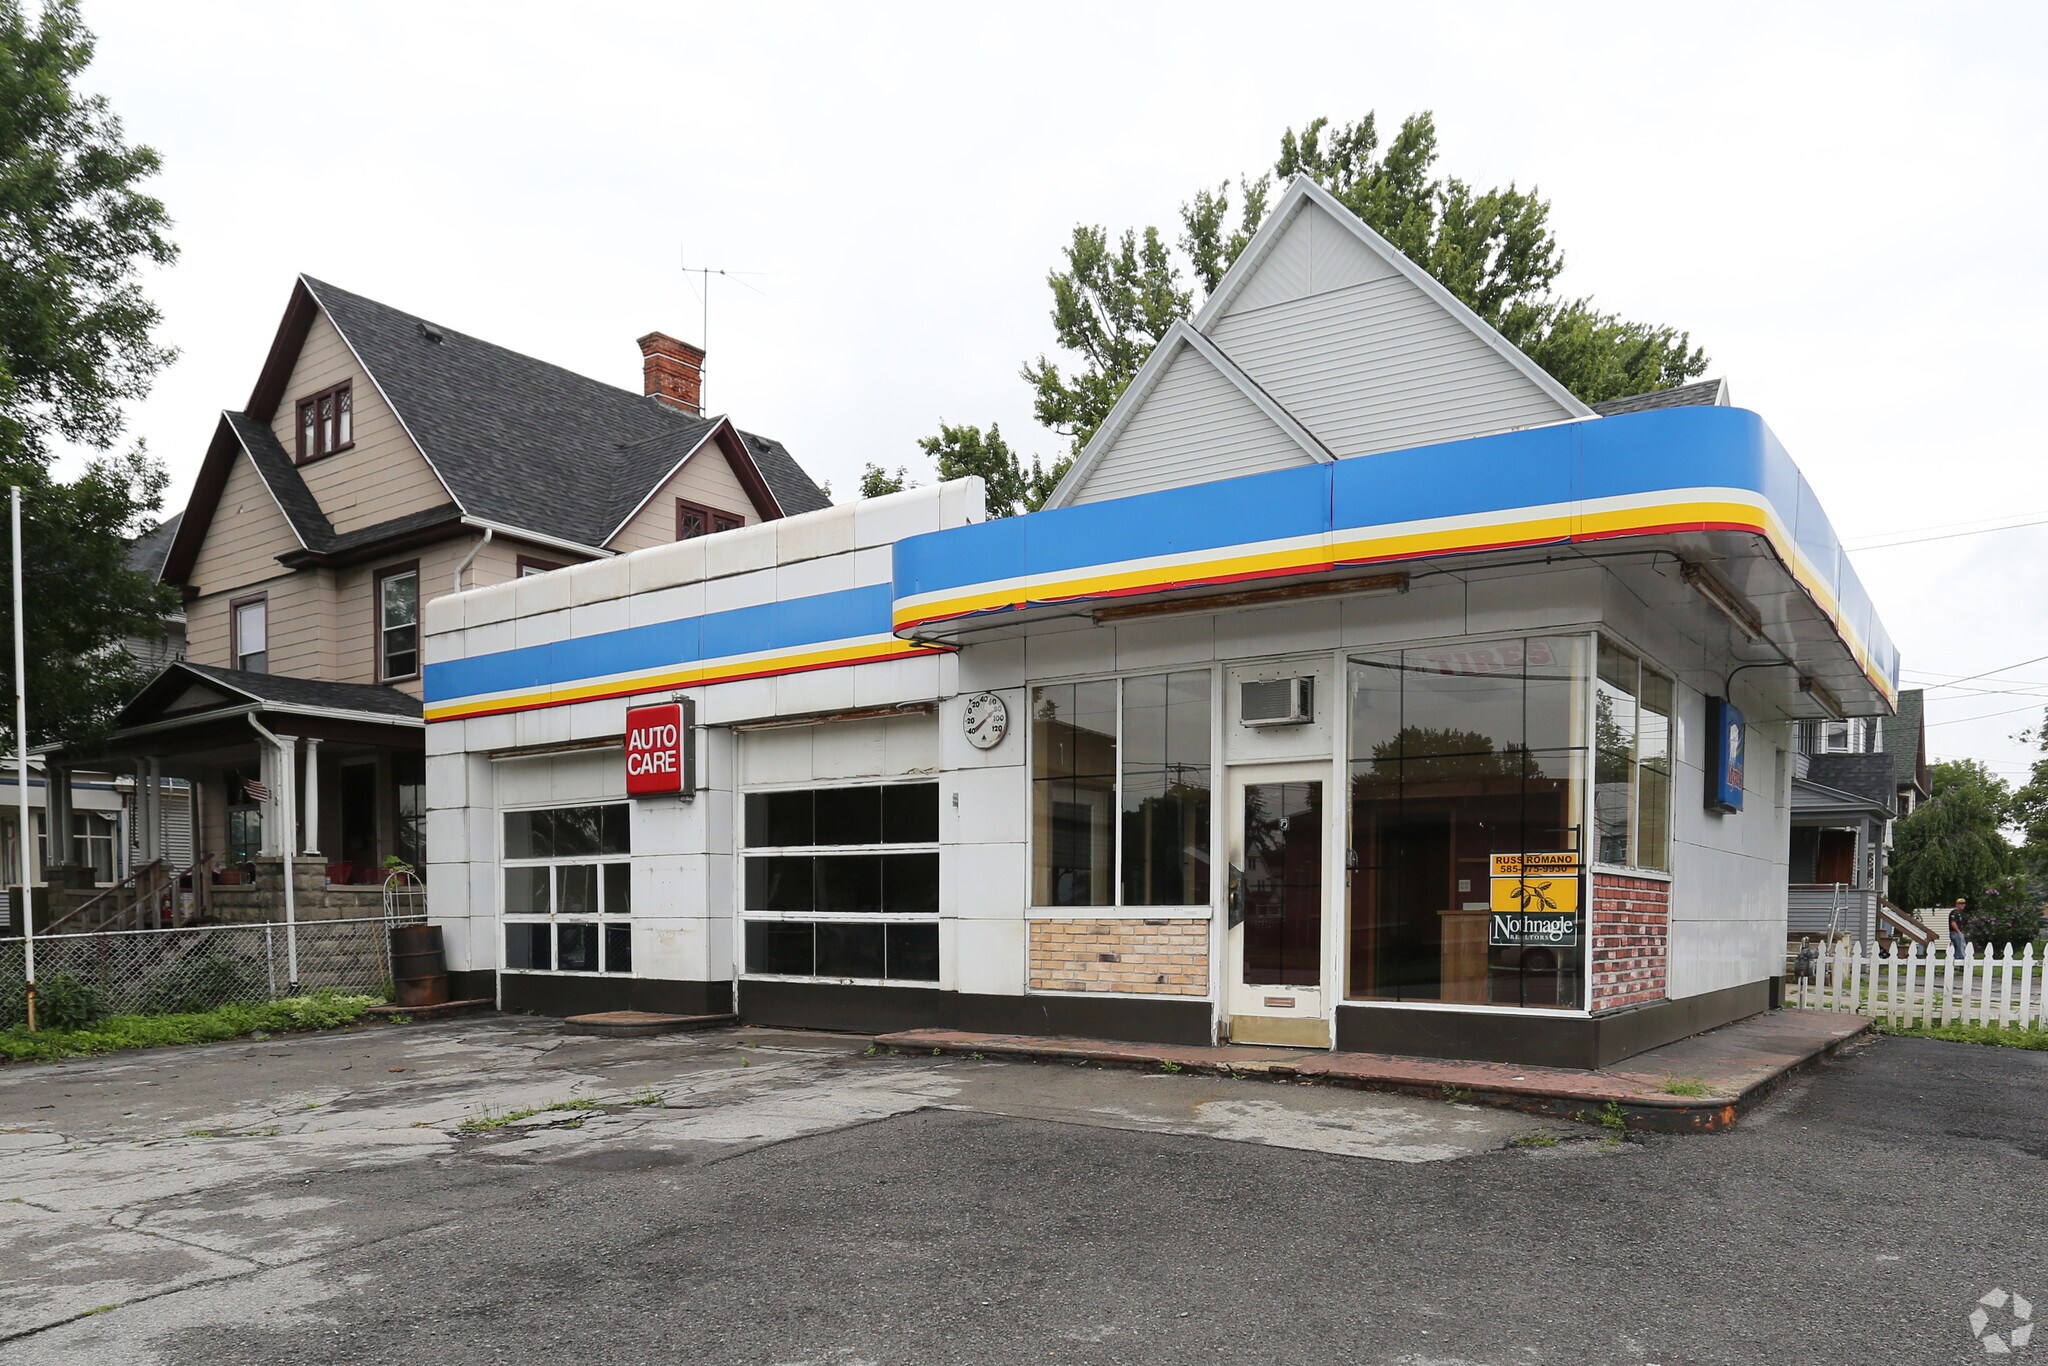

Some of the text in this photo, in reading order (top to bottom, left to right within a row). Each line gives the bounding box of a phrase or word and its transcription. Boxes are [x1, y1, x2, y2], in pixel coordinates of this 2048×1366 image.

[1427, 642, 1551, 675] TIRES
[980, 695, 988, 703] 40
[628, 724, 677, 751] AUTO
[627, 750, 677, 776] CARE
[1496, 855, 1572, 864] RUSS ROMANO
